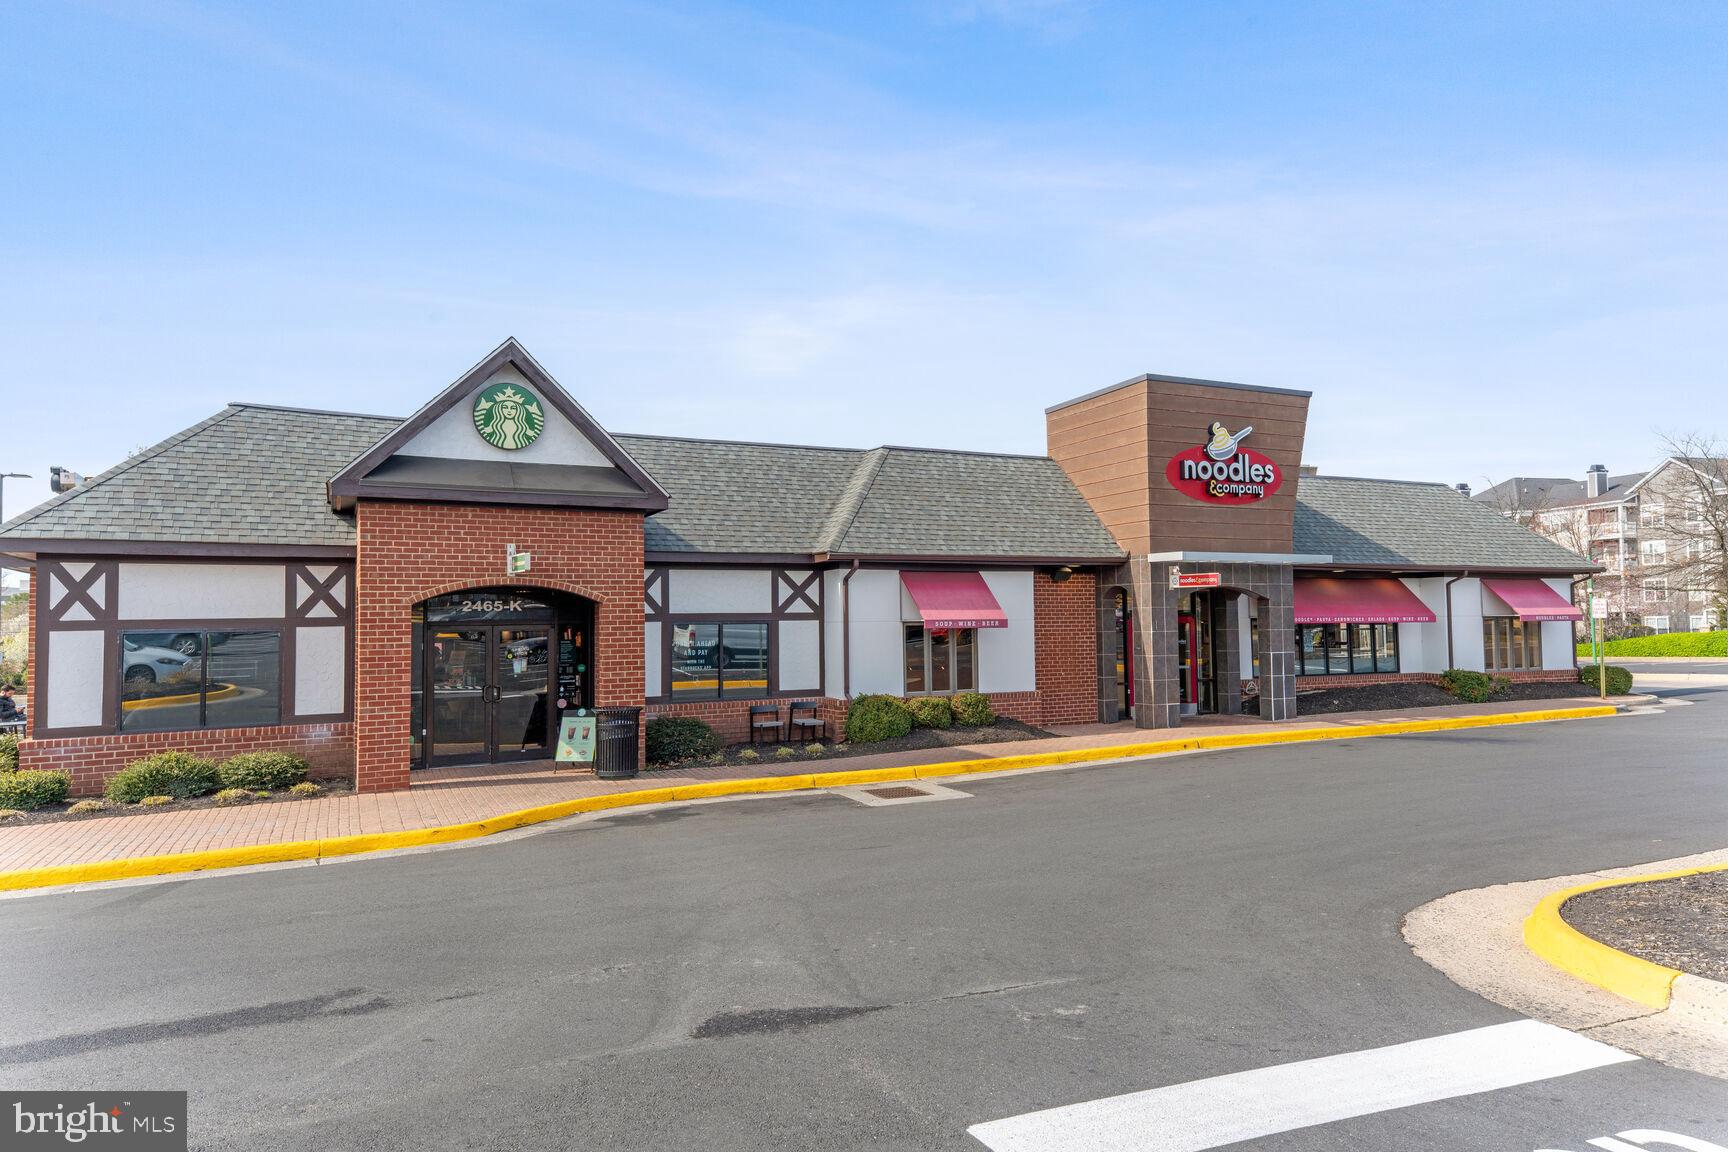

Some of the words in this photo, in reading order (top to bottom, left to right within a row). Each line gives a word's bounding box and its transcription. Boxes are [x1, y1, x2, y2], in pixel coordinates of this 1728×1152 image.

[1182, 453, 1275, 484] noodles
[1209, 479, 1265, 498] &company
[462, 600, 522, 612] 2465-K
